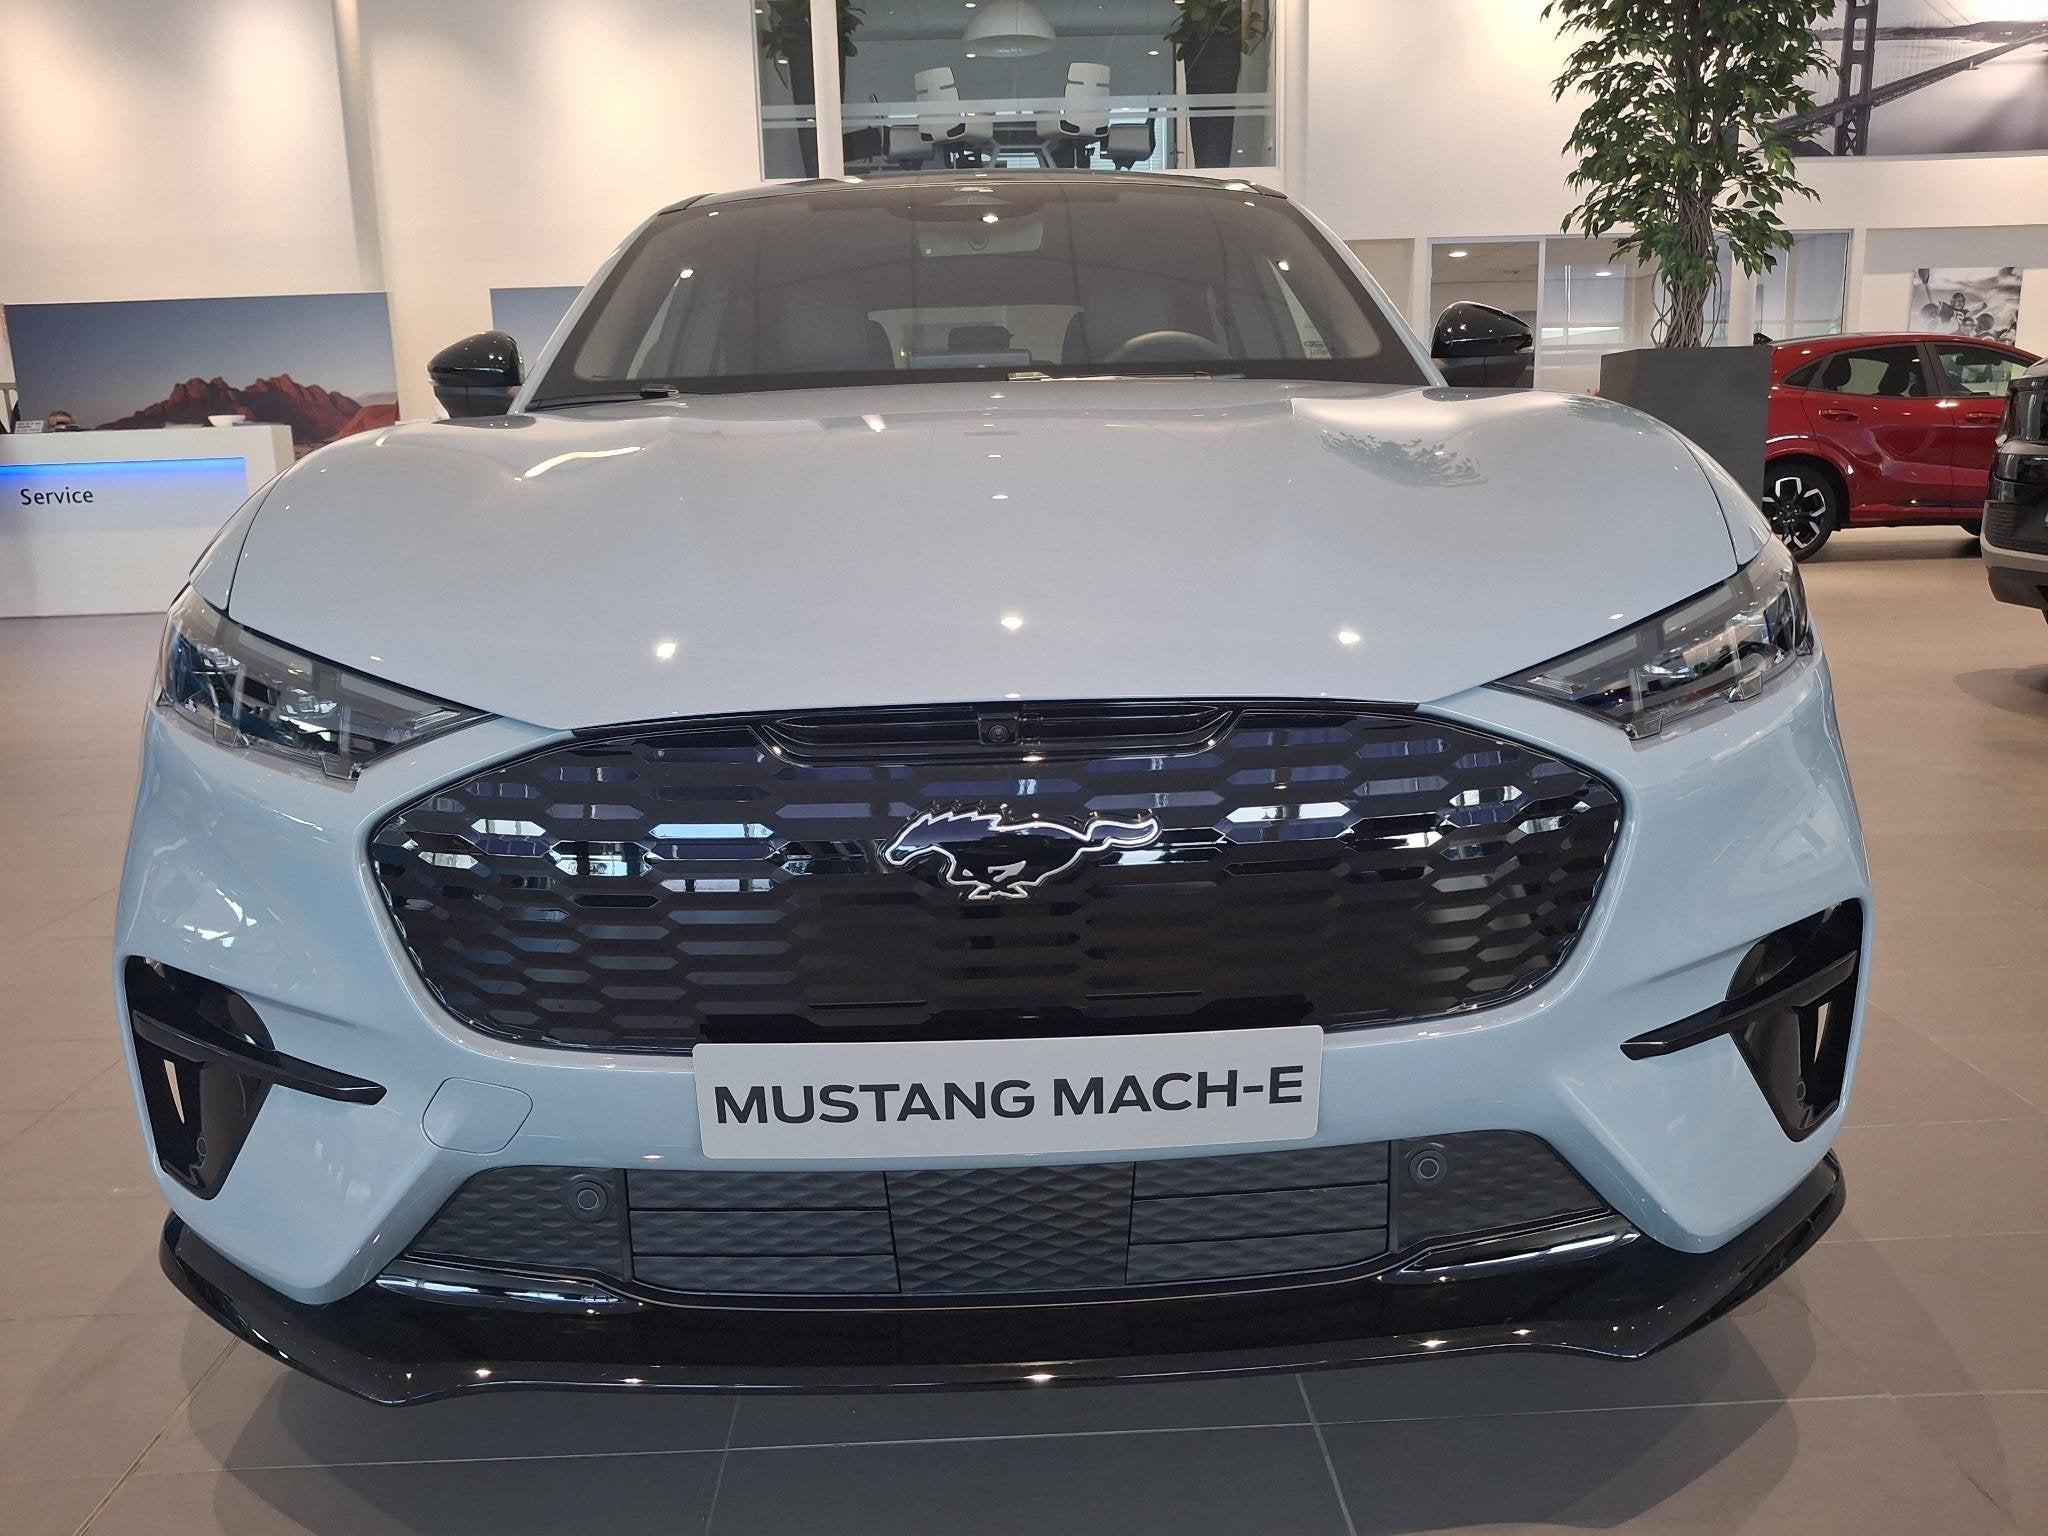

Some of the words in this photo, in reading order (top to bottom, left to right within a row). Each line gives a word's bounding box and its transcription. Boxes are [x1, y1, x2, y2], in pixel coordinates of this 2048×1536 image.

[20, 486, 94, 506] Service
[714, 1080, 1035, 1124] MUSTANG
[1053, 1065, 1304, 1117] MACH-E
